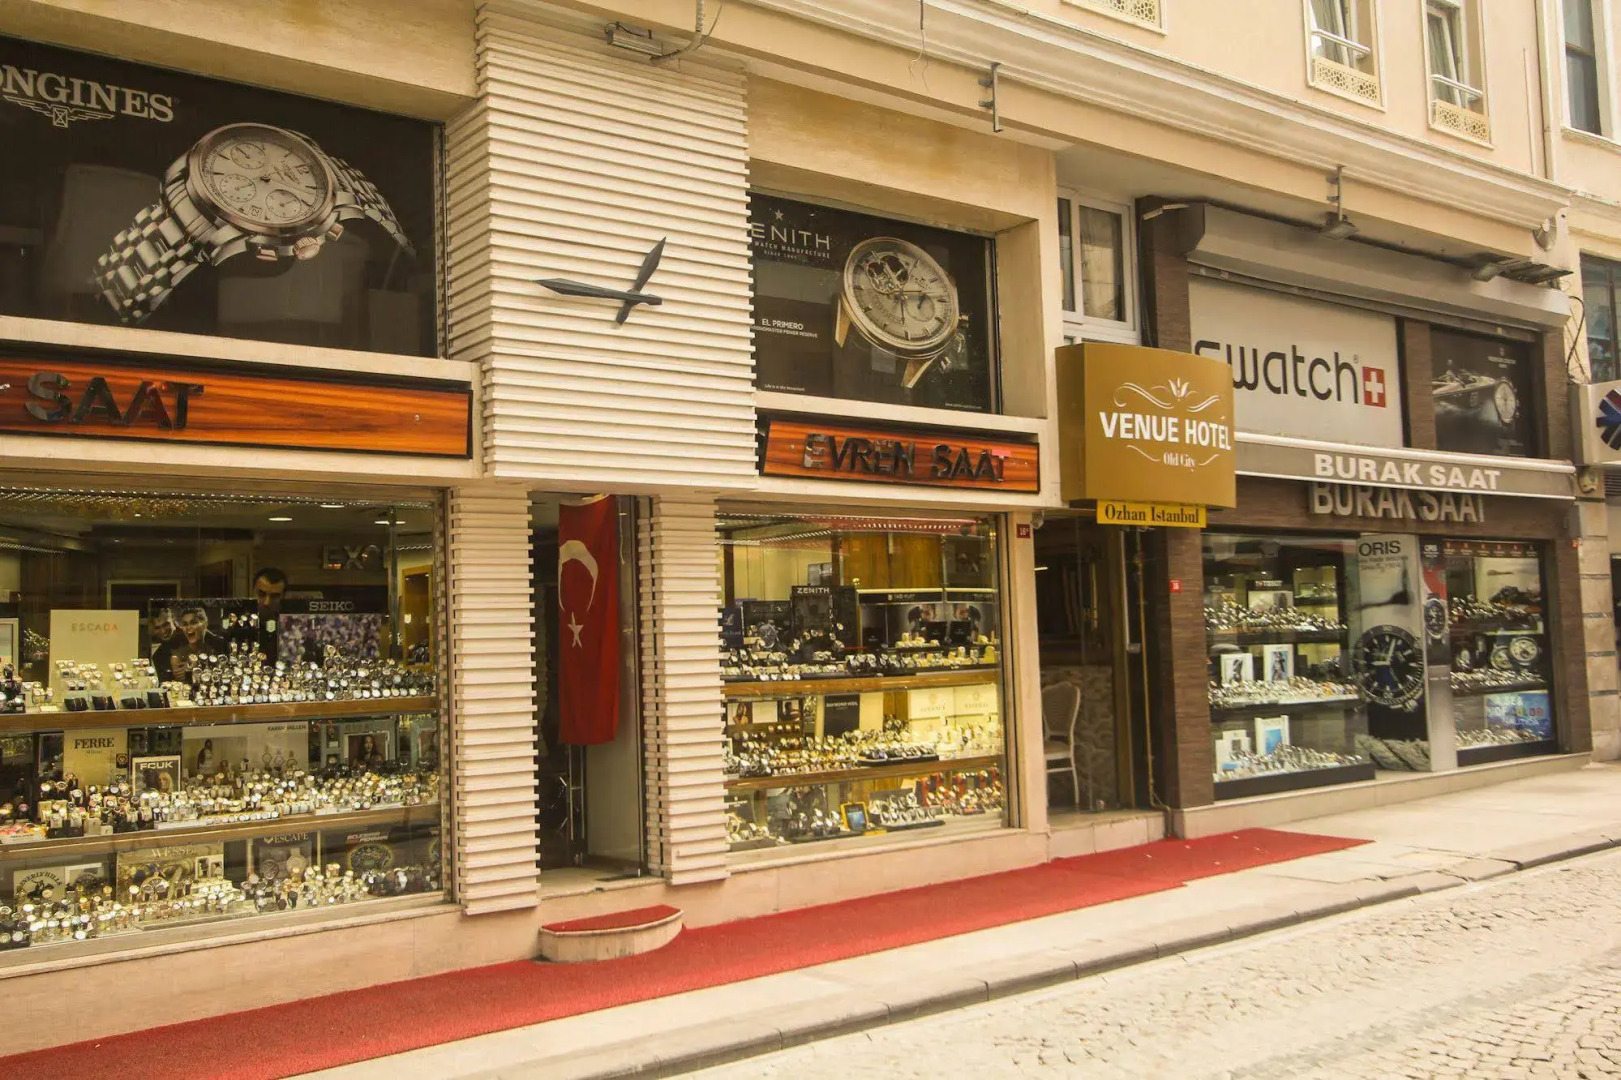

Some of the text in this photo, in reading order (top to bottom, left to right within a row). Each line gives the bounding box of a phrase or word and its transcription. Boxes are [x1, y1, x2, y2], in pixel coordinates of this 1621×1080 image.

[0, 64, 174, 123] NGINES
[751, 222, 830, 250] ENITH
[754, 241, 830, 259] WATCH MANUFACTURE
[762, 318, 804, 330] EL PRIMERO
[24, 370, 205, 431] SAAT
[1099, 411, 1232, 450] VENUE HOTEL
[803, 433, 1012, 484] EVREN SAAT
[1163, 451, 1196, 472] Old City
[1314, 453, 1501, 490] BURAK SAAT
[1311, 480, 1417, 520] BURAK
[1104, 503, 1200, 523] Ozhan Istanbul
[1358, 540, 1402, 557] ORIS
[309, 601, 355, 612] SEIKO
[71, 622, 118, 632] ESCADA
[74, 737, 115, 750] FERRE
[140, 760, 173, 770] FCUK
[274, 832, 309, 844] ESCAPE
